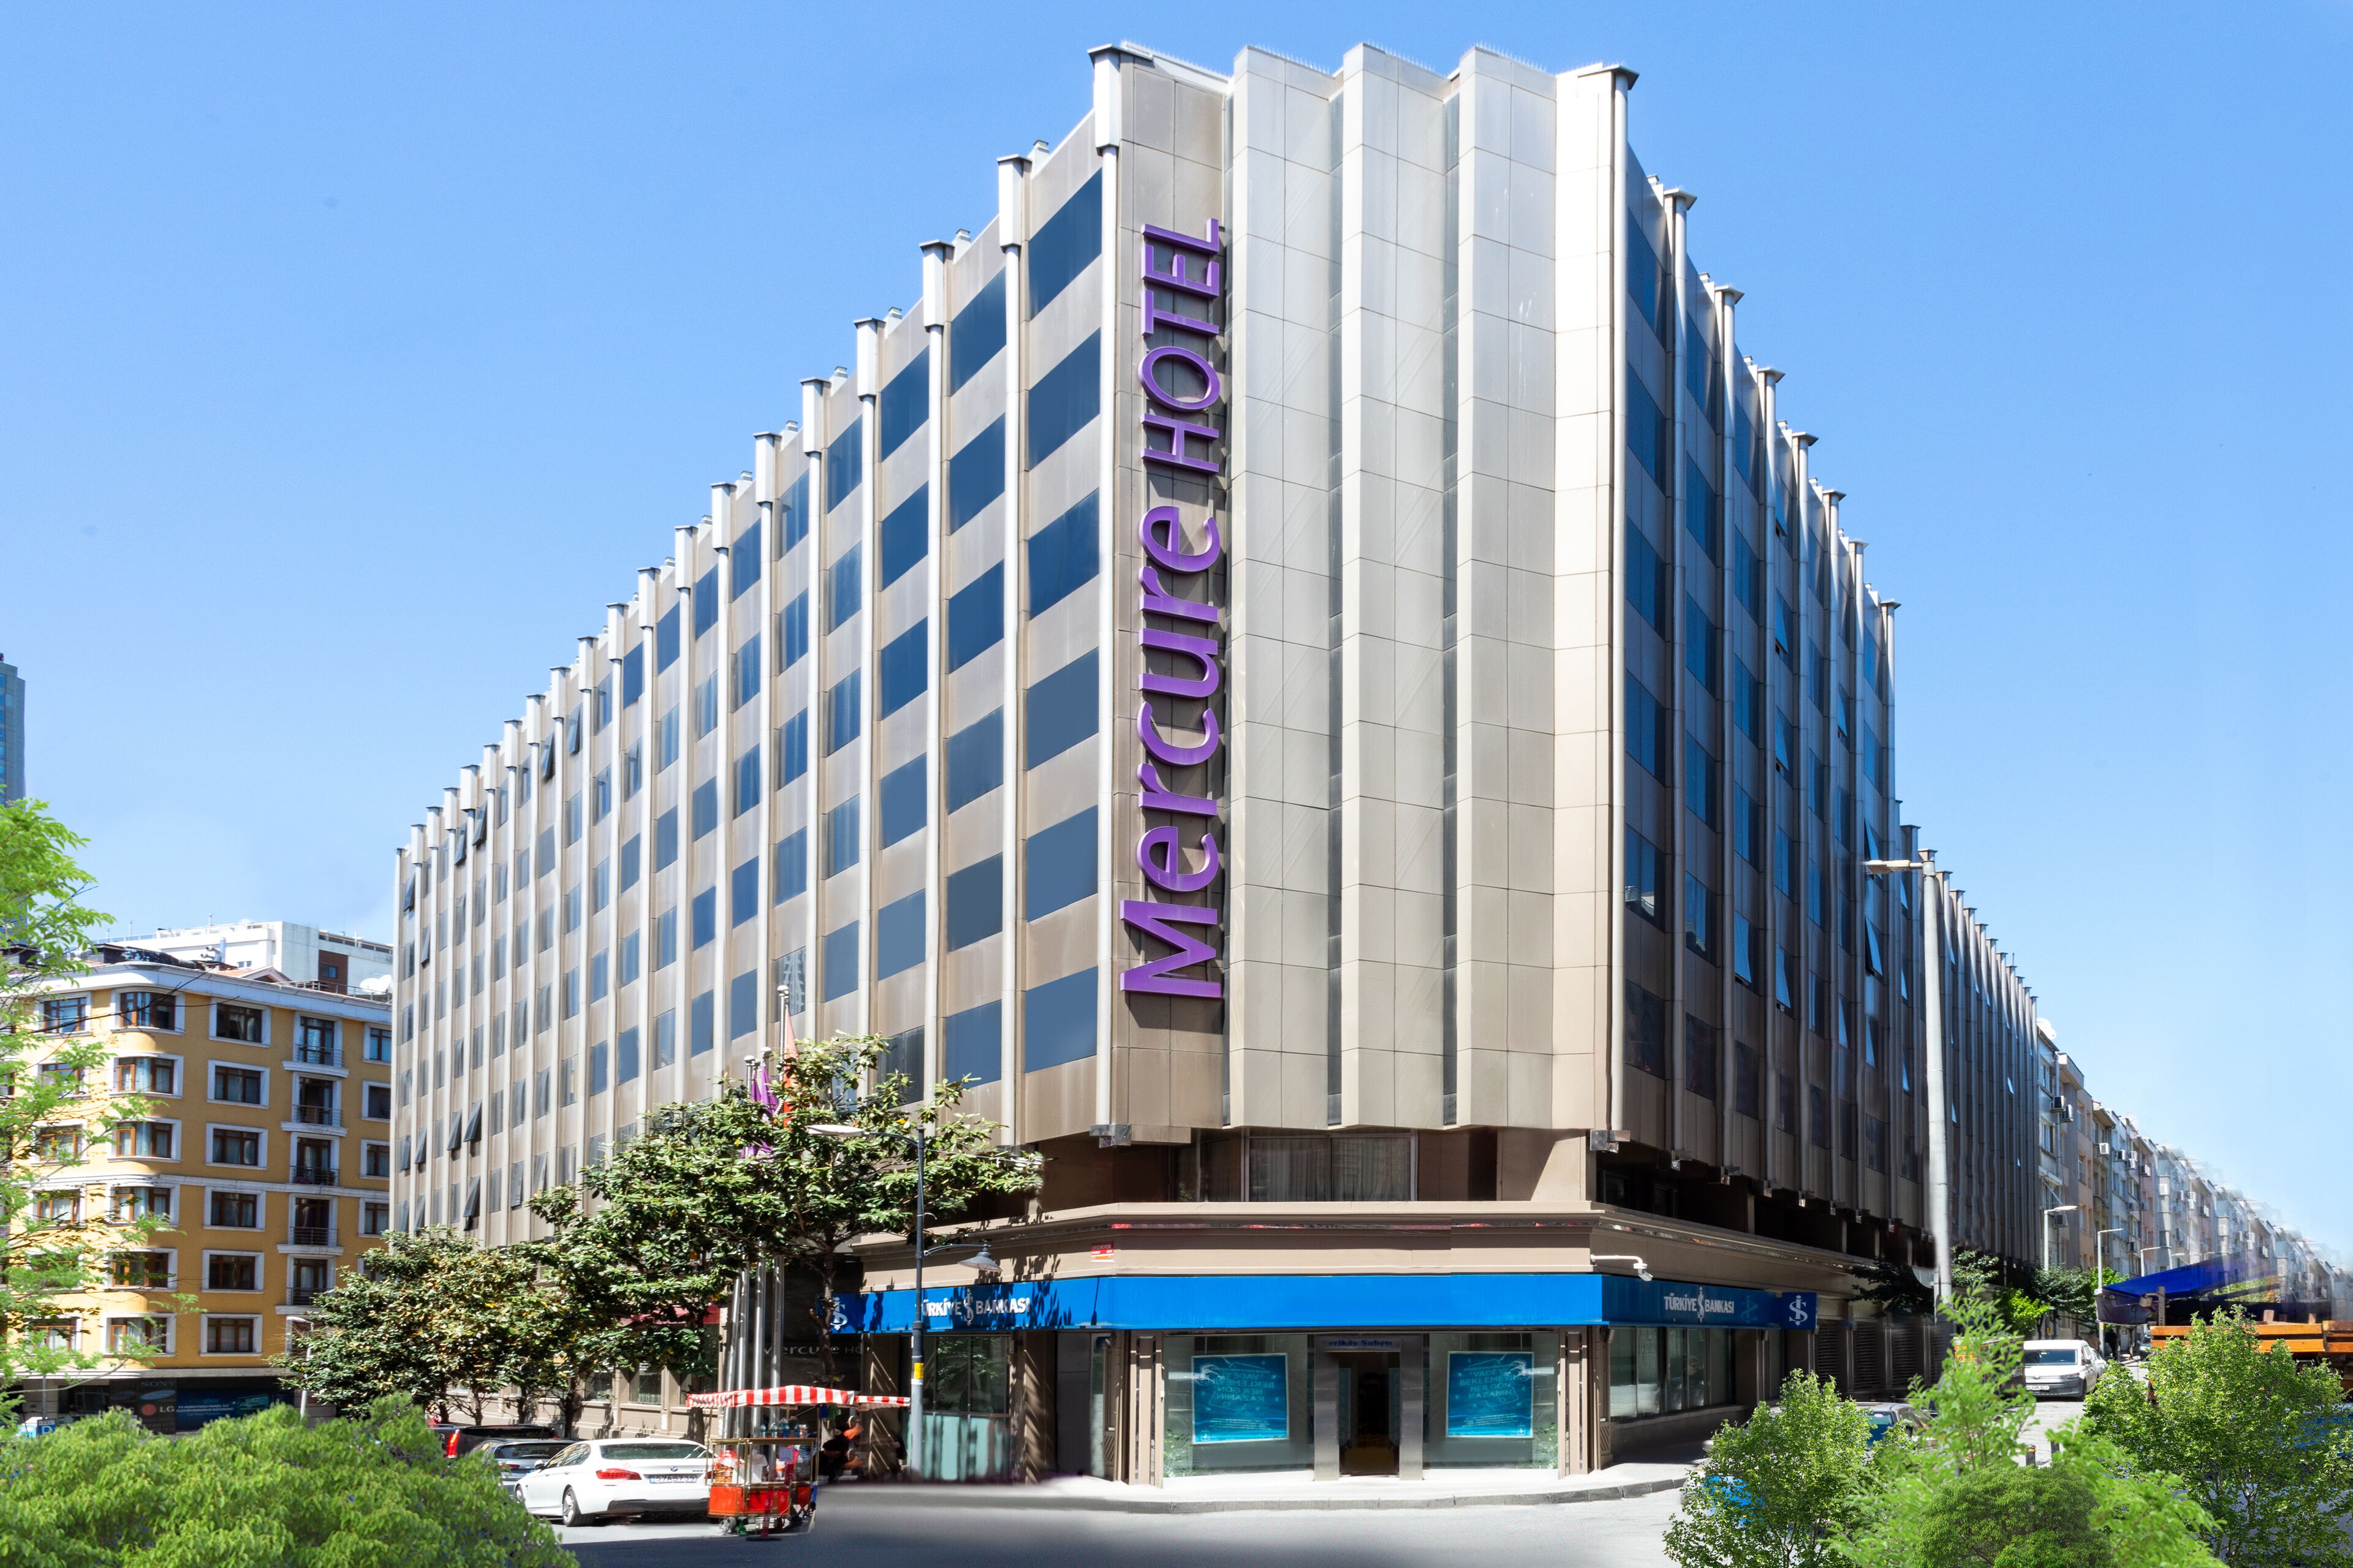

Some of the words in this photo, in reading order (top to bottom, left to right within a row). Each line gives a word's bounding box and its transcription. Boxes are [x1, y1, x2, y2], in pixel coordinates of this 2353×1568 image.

[1139, 218, 1221, 475] HOTEL
[1120, 506, 1223, 999] Mercure
[915, 1298, 962, 1317] ÜRKİYE
[976, 1297, 1030, 1314] BANKASI
[1664, 1292, 1697, 1312] TÜRKİYE
[1705, 1299, 1734, 1314] BANKASI
[1490, 1382, 1511, 1390] GÜN
